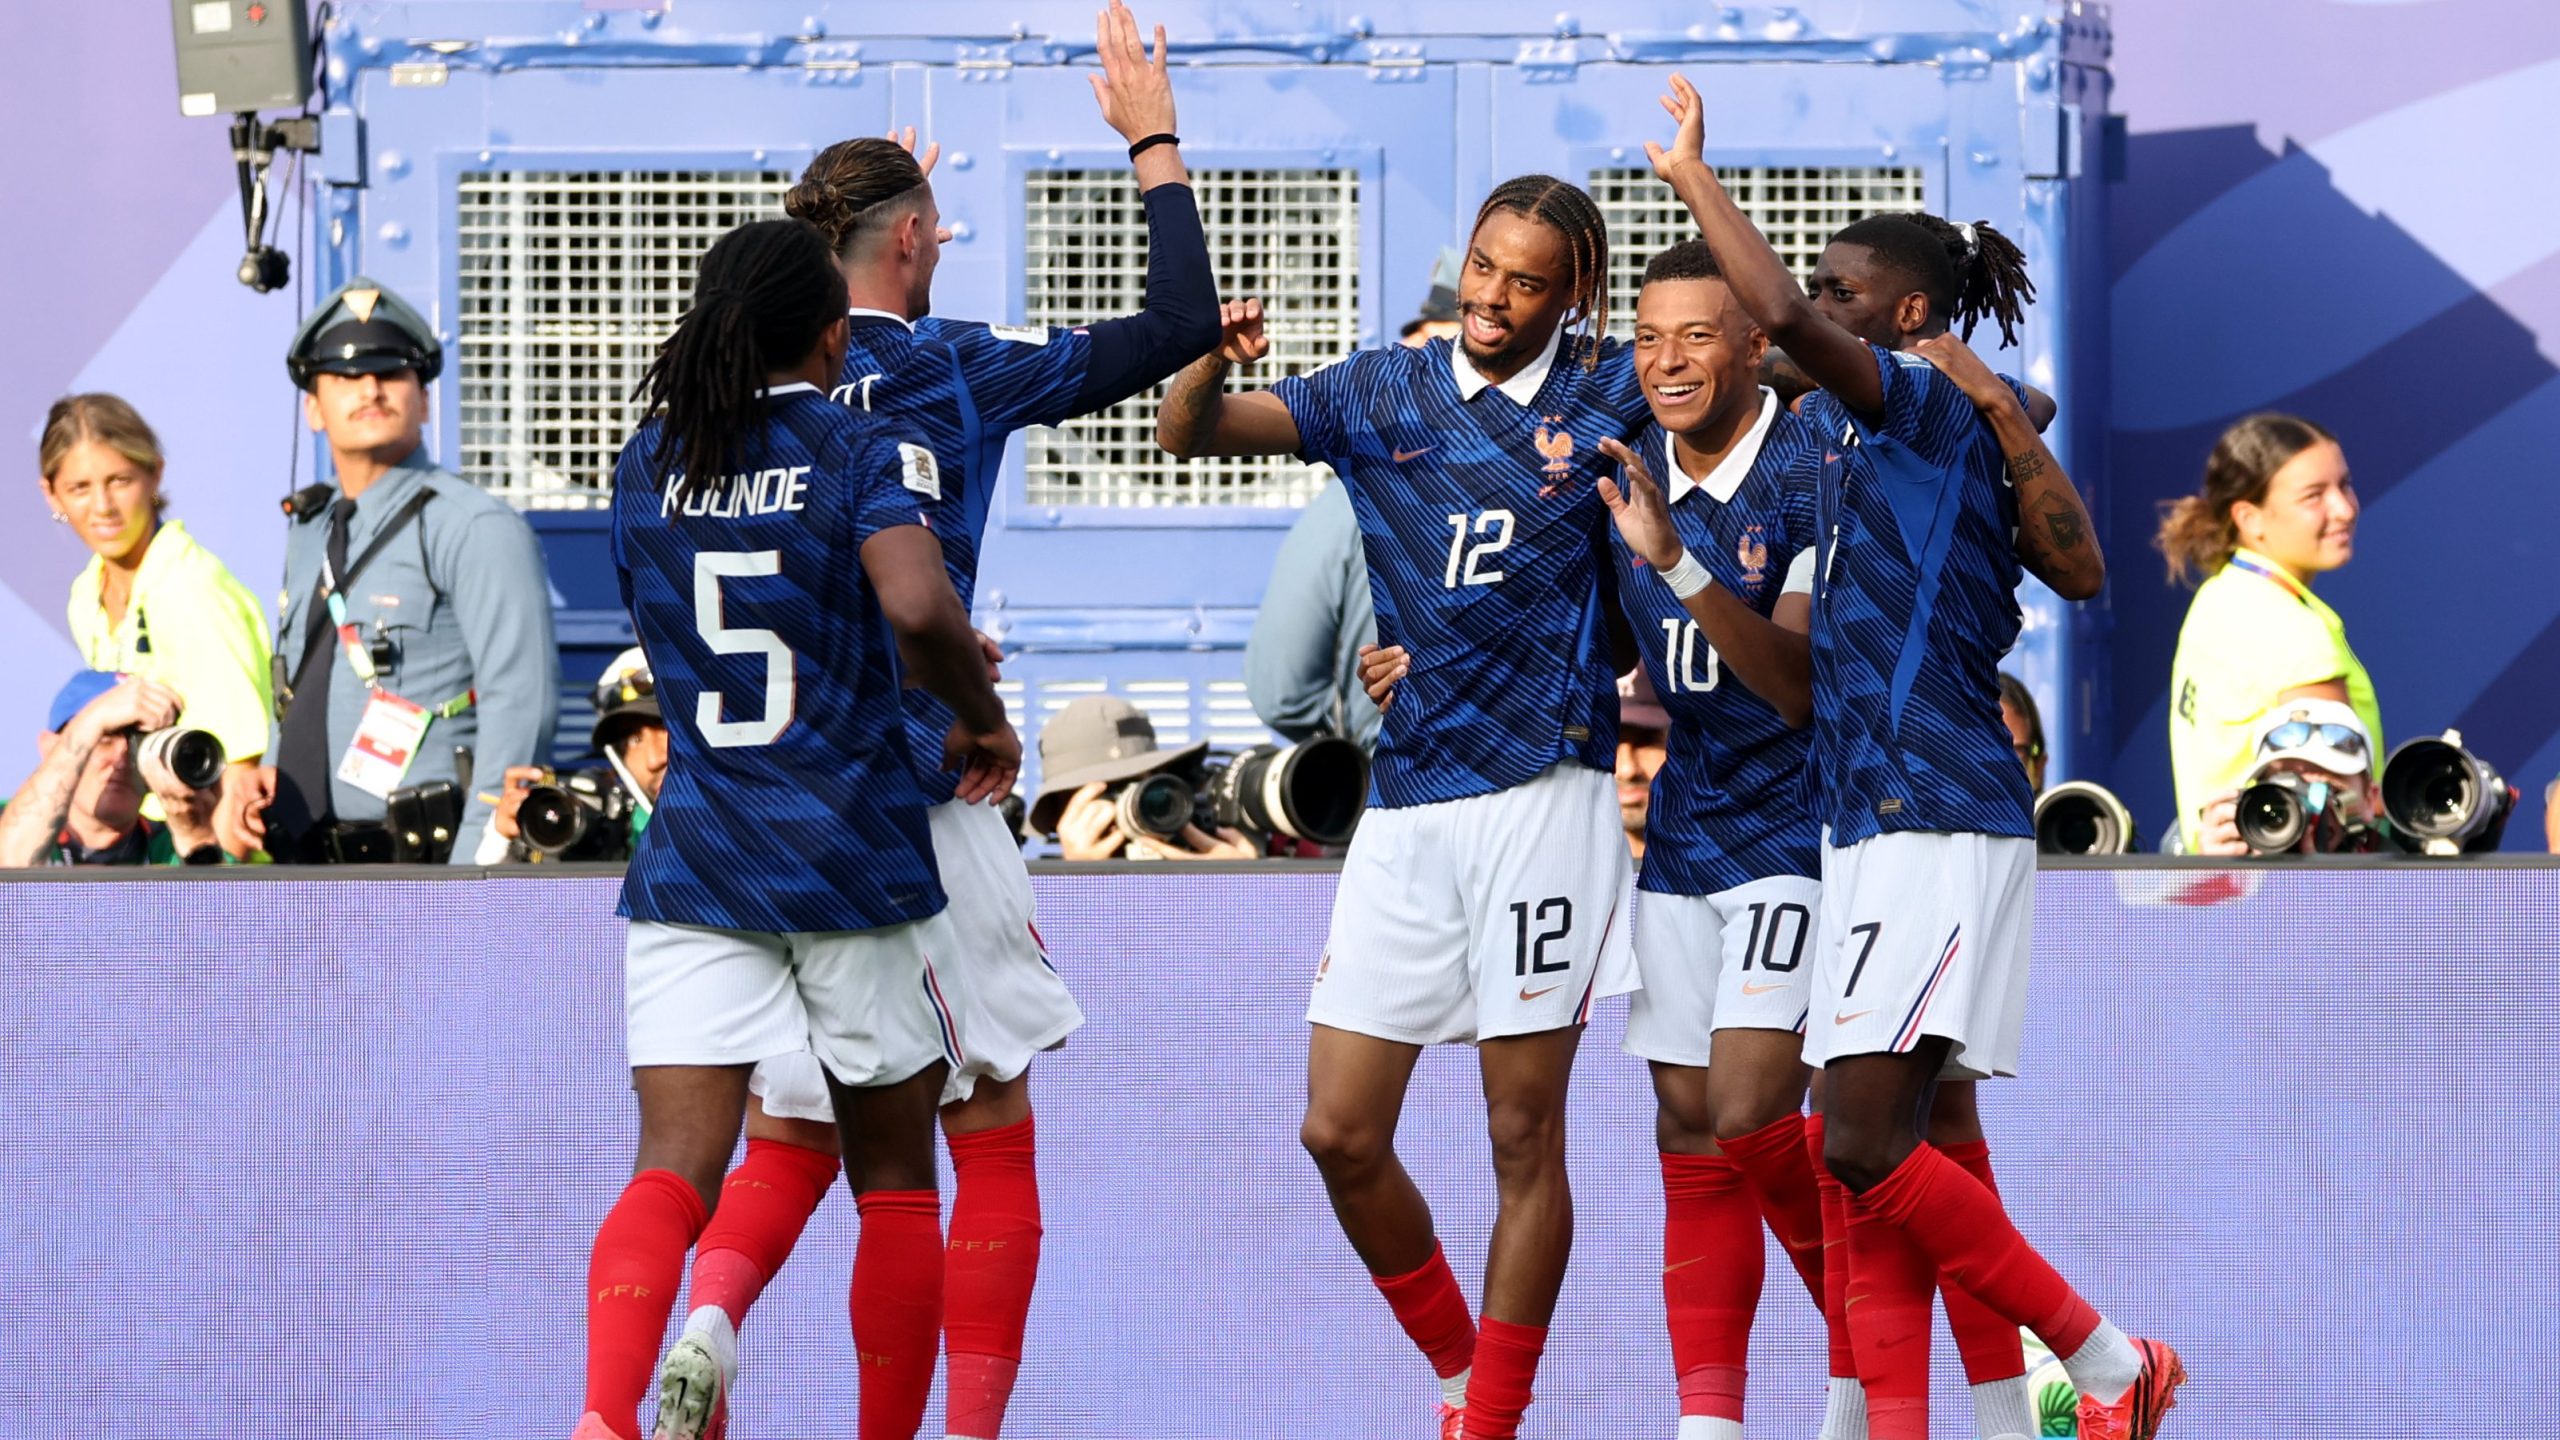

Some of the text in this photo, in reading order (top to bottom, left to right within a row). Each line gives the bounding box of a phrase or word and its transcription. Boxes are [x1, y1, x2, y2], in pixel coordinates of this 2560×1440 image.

[659, 465, 812, 519] KOUNDE
[1444, 508, 1516, 589] 12
[693, 549, 796, 749] 5
[1661, 618, 1719, 694] 10
[1509, 896, 1573, 978] 12
[1741, 902, 1812, 973] 10
[1843, 921, 1882, 999] 7
[950, 1239, 1007, 1251] FFF
[597, 1284, 651, 1304] FFF
